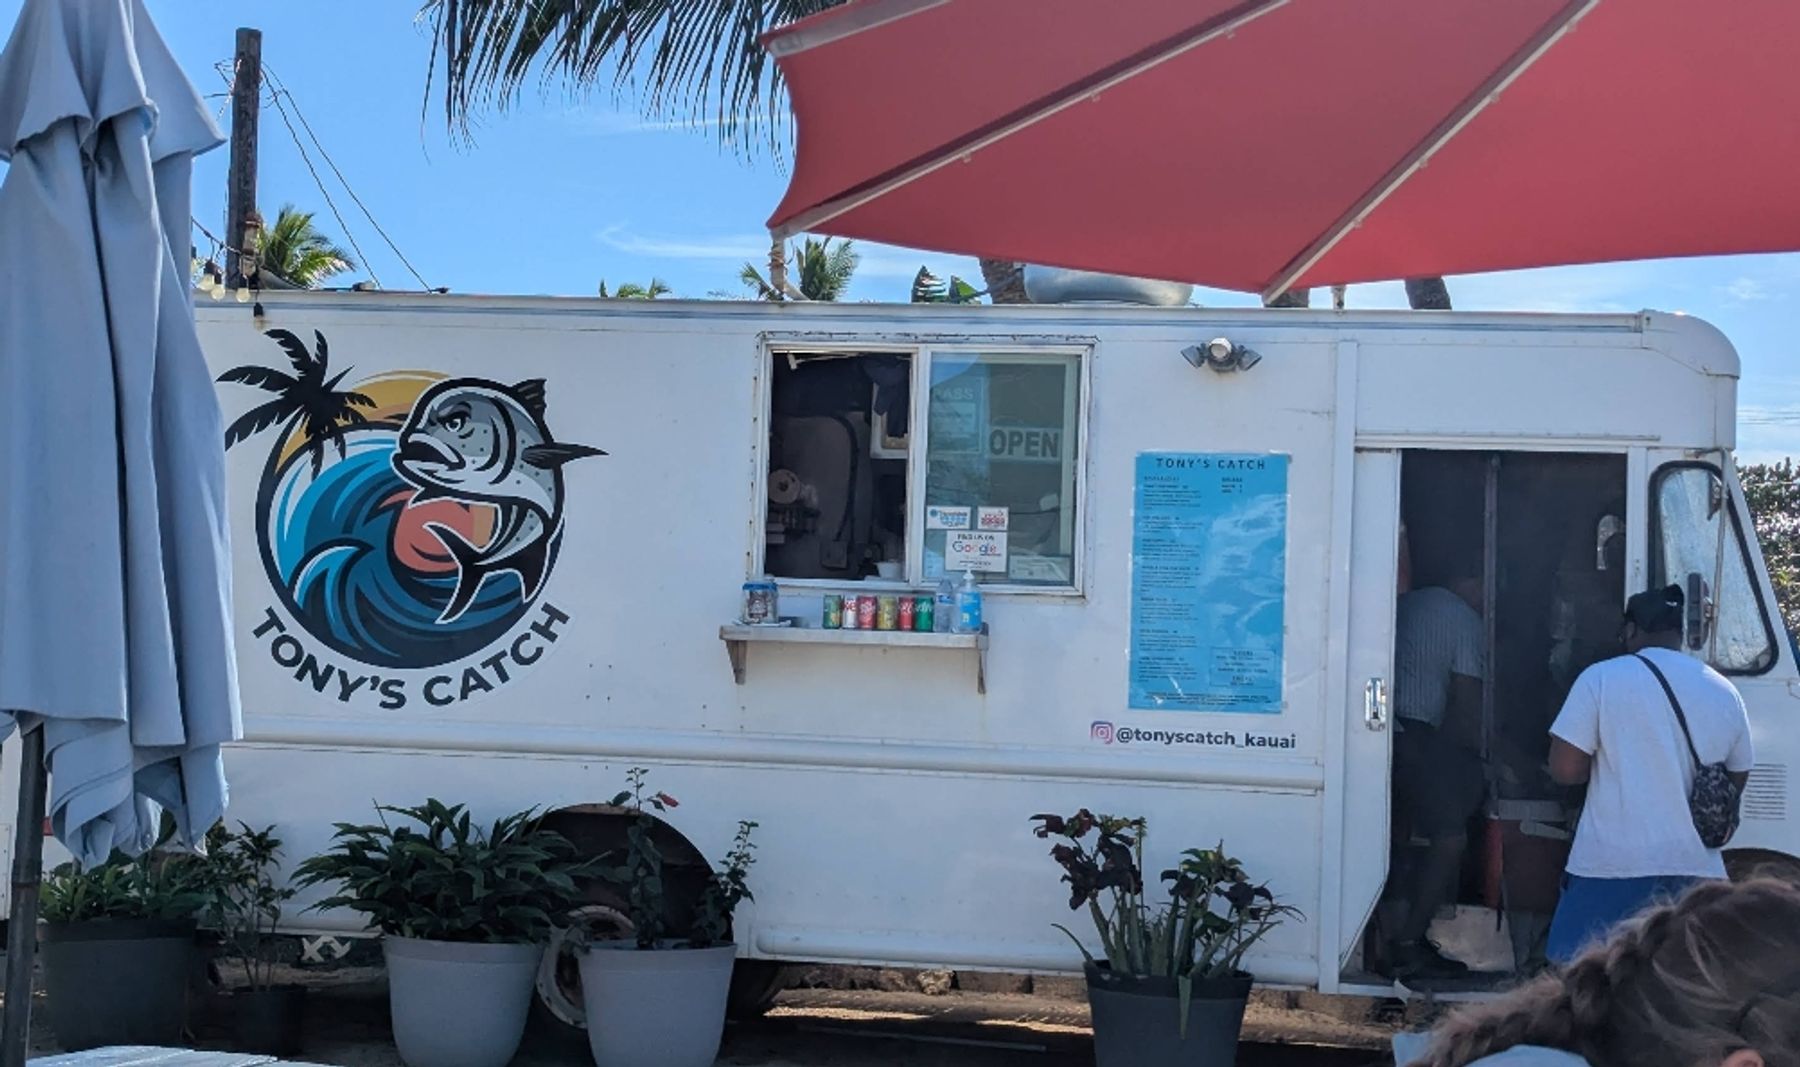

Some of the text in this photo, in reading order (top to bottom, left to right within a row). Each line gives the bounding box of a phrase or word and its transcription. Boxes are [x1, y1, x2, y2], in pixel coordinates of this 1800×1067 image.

[990, 429, 1059, 458] OPEN
[1156, 458, 1265, 470] TONY'S CATCH
[952, 540, 998, 556] Goge
[253, 602, 570, 709] TONY'S CATCH
[1116, 727, 1296, 749] @tonyscatch_kauai
